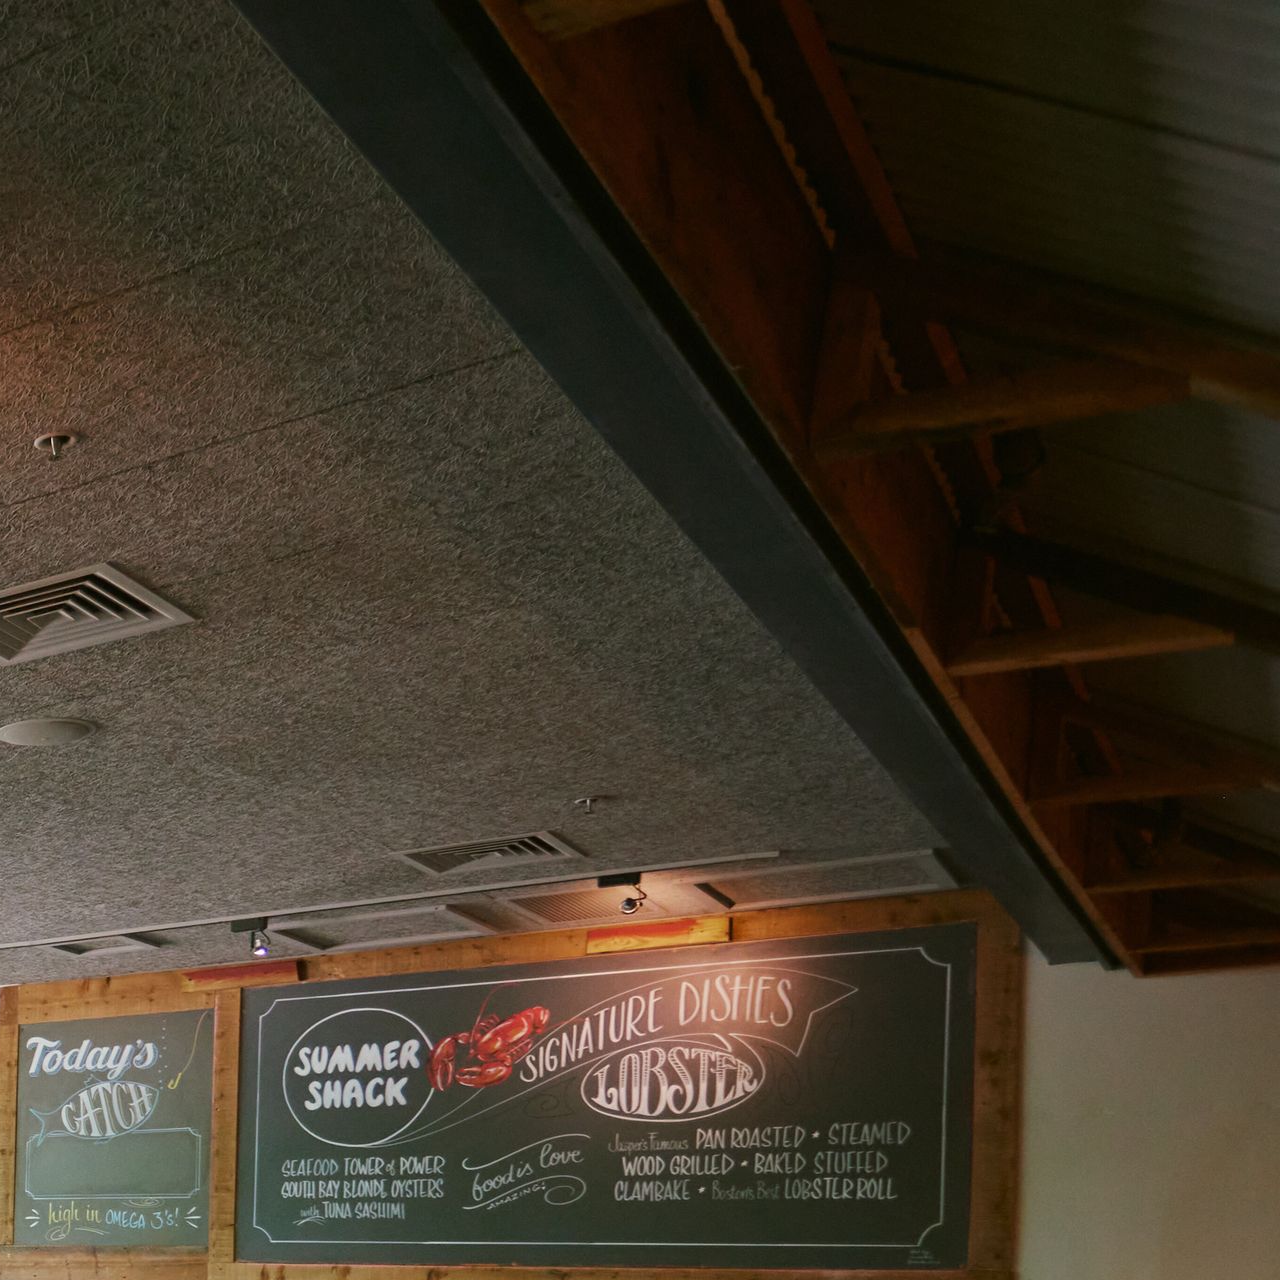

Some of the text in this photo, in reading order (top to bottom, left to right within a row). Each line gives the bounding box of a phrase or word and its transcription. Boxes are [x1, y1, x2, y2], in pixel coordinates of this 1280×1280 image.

[520, 974, 795, 1083] SIGNATURE DISHES
[26, 1036, 159, 1080] Today's
[294, 1039, 420, 1076] SUMMER
[304, 1077, 408, 1111] SHACK
[591, 1046, 758, 1116] LOBSTER
[61, 1082, 153, 1137] CATCH
[695, 1127, 727, 1150] PAN
[730, 1124, 807, 1150] ROASTED
[827, 1121, 911, 1145] STEAMED
[281, 1159, 339, 1177] SEAFOOD
[344, 1157, 385, 1177] TOWER
[400, 1155, 446, 1176] POWER
[472, 1163, 515, 1201] food
[540, 1143, 584, 1169] love
[622, 1151, 889, 1177] WOOD GRILLED BAKED STUFFED
[281, 1178, 444, 1199] SOUTH BAY BLONDE OYSTERS
[614, 1179, 691, 1202] CLAMBAKE
[784, 1177, 854, 1200] LOBSTER
[856, 1177, 898, 1200] ROLL
[48, 1200, 79, 1237] high
[86, 1205, 101, 1223] in
[105, 1208, 145, 1229] OMEGA
[322, 1201, 352, 1219] TUNA
[354, 1202, 406, 1219] SASHIMI
